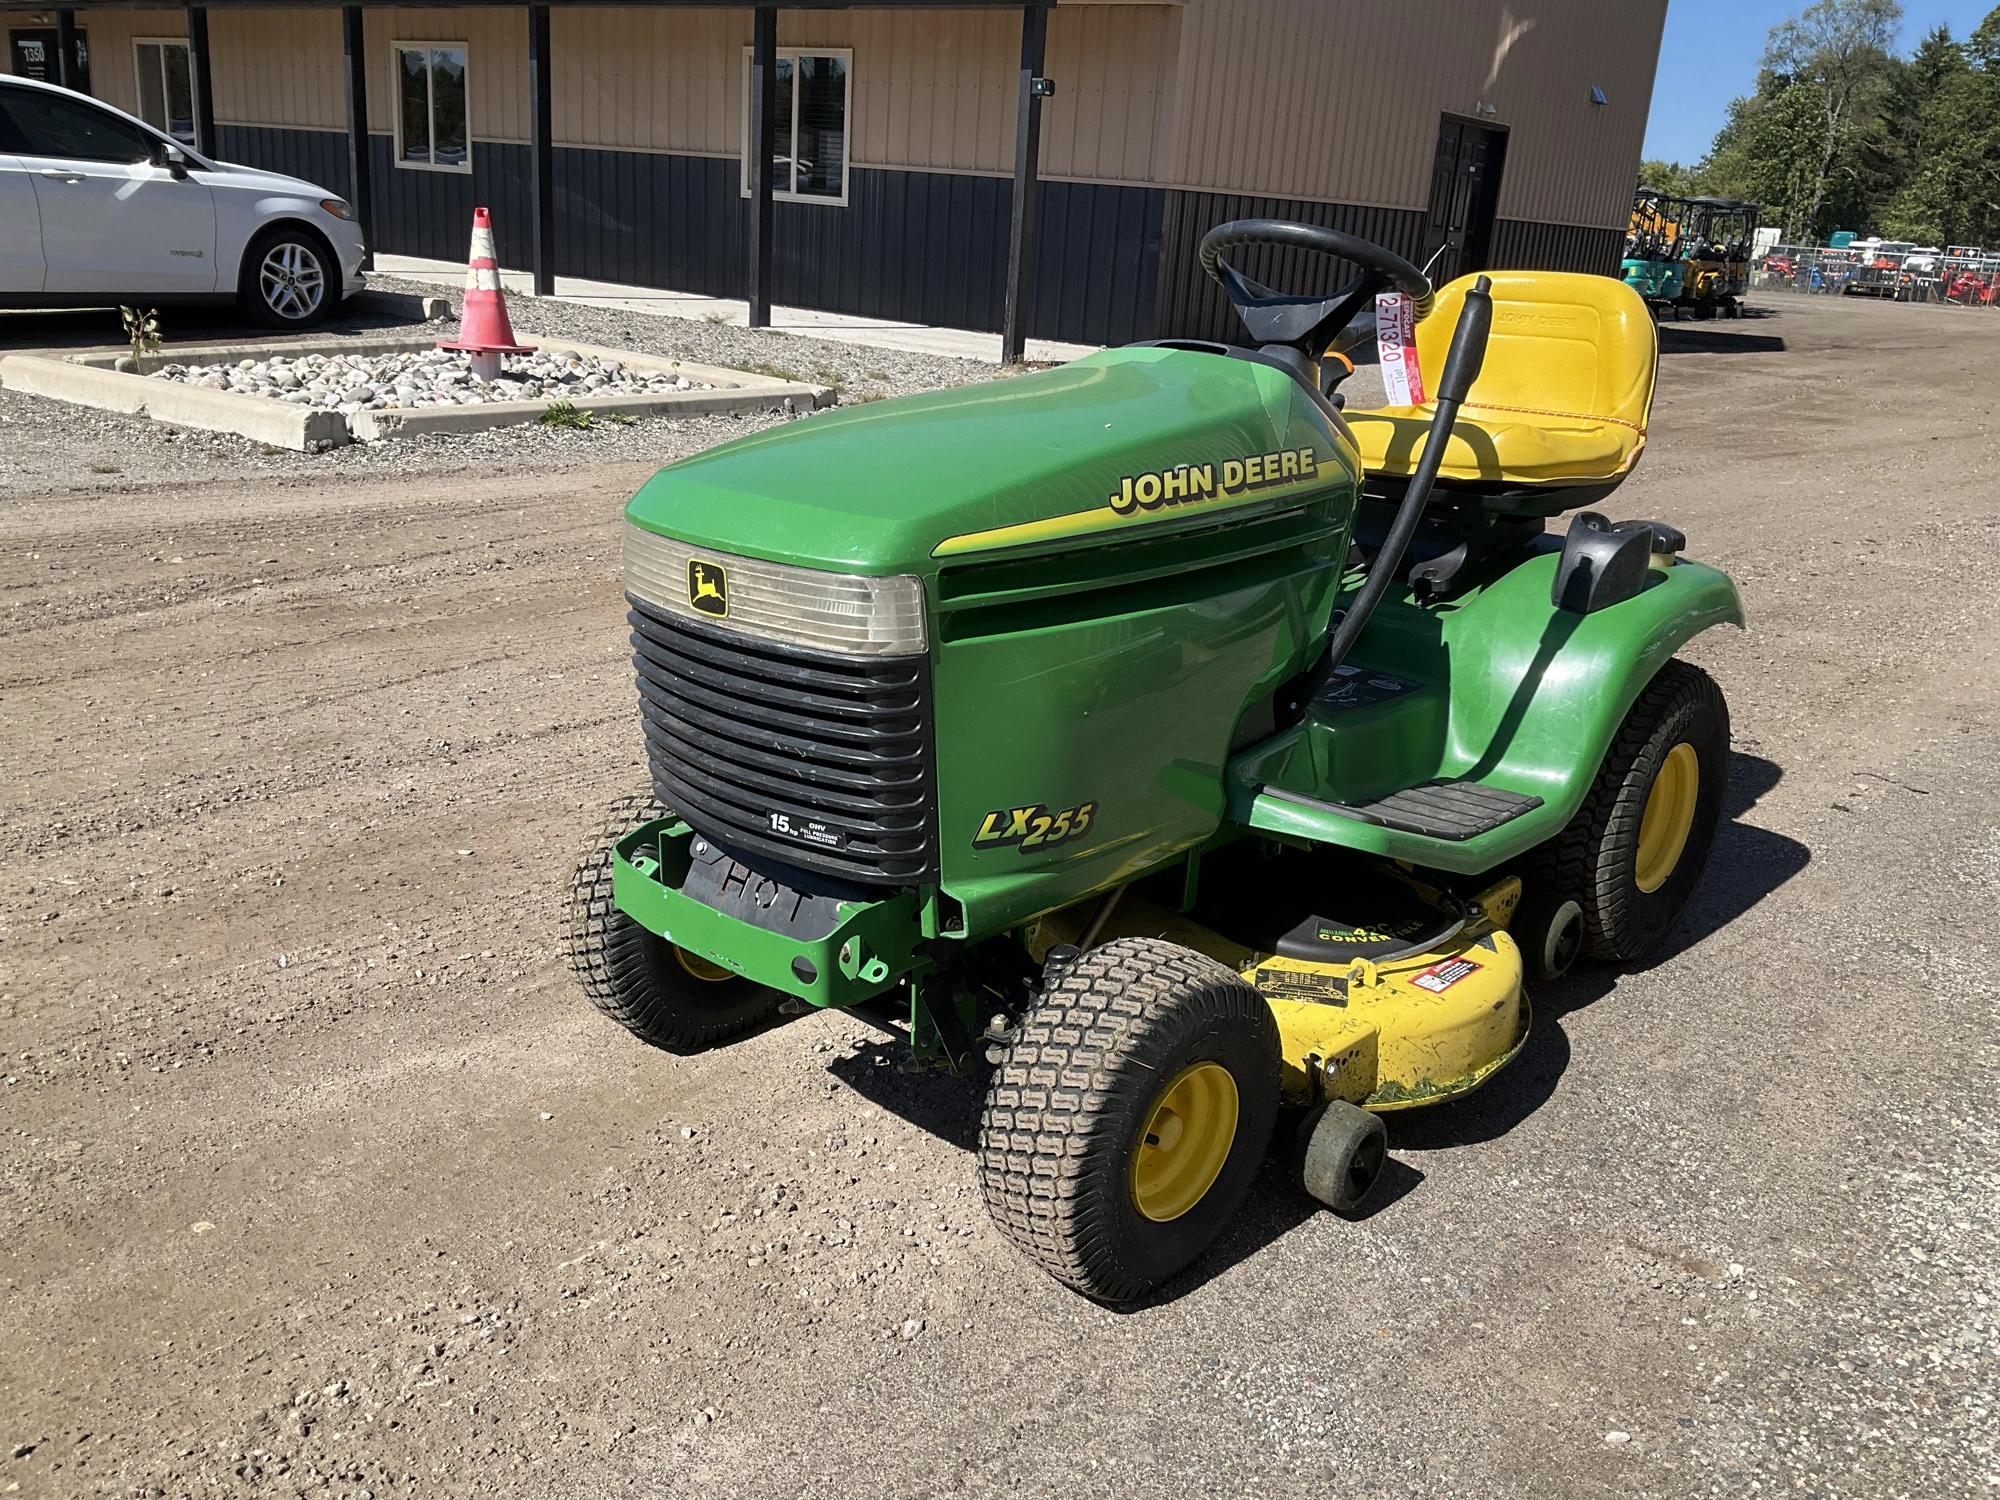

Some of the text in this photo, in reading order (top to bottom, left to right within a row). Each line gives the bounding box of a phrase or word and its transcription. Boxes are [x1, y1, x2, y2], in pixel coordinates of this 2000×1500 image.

[24, 48, 45, 62] 1350
[1379, 297, 1402, 362] 2-71320
[1403, 300, 1411, 339] REPOCAST
[1497, 312, 1578, 329] JOHN DEERE
[1109, 448, 1317, 511] JOHN DEERE
[799, 827, 838, 841] FULL PRESSURE
[808, 822, 826, 832] OHV
[973, 802, 1096, 851] LX255
[804, 833, 837, 846] LUBRICATION
[722, 861, 814, 922] HOT
[1318, 920, 1424, 943] CONVERTIBLE
